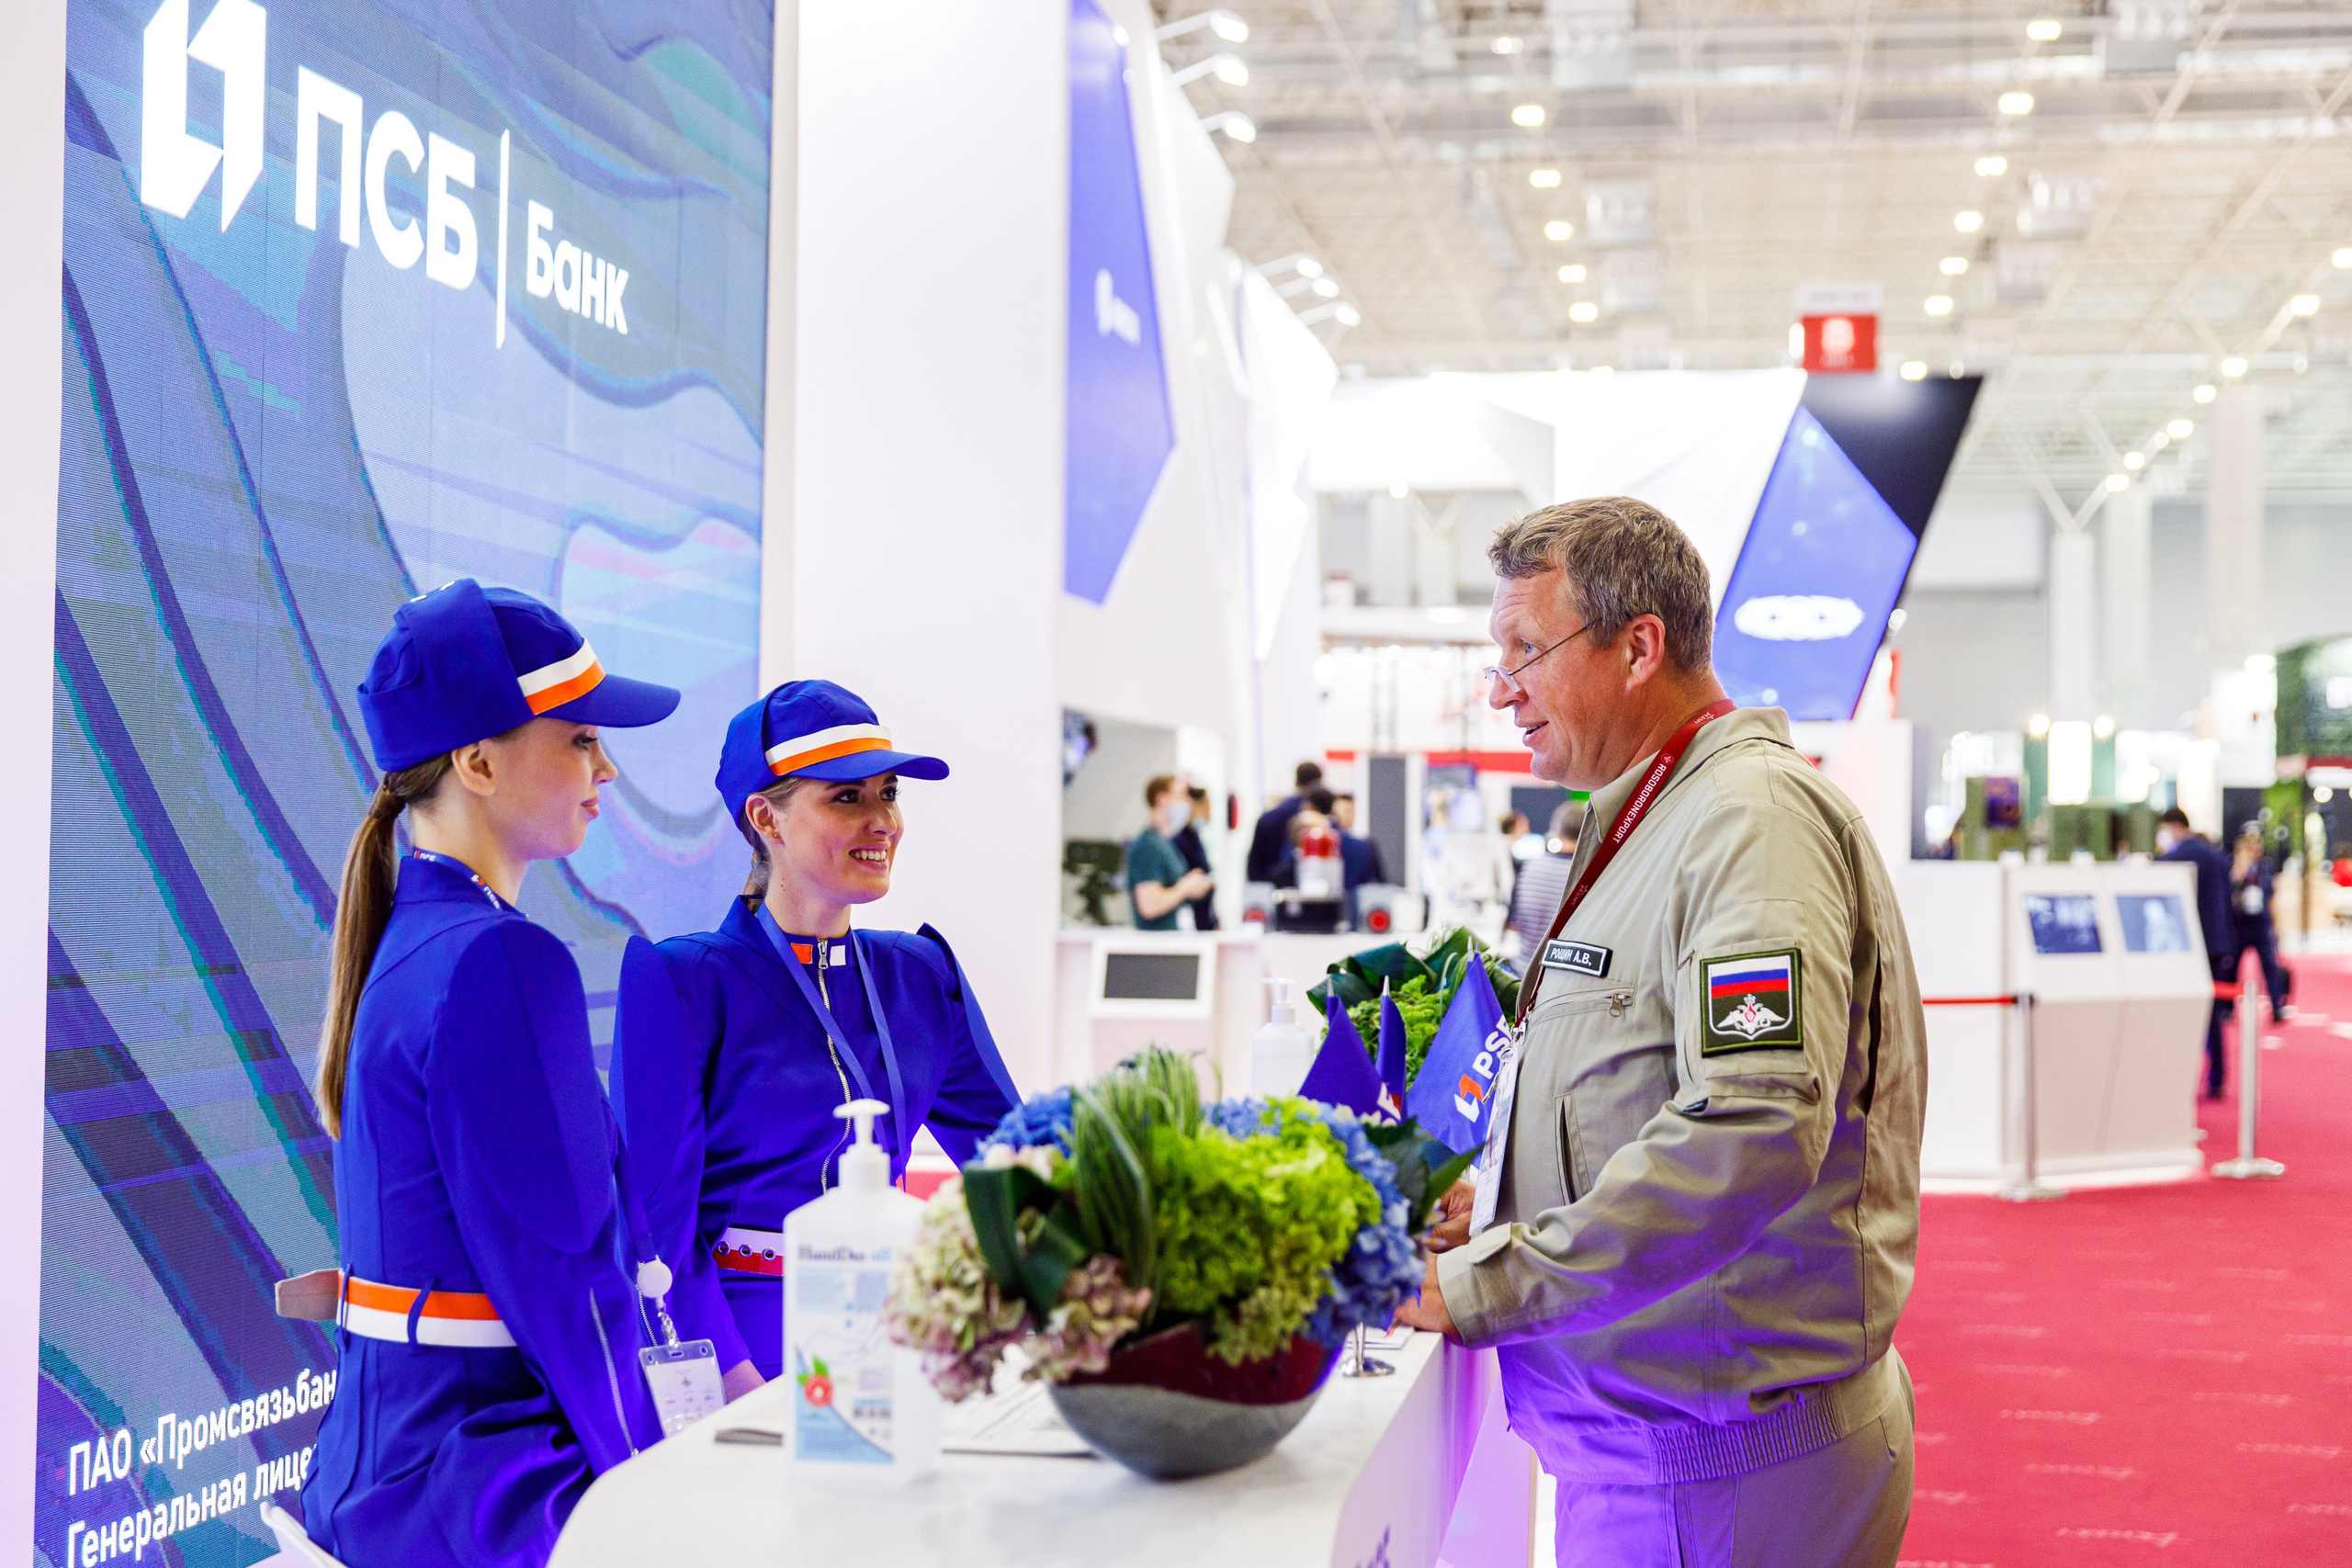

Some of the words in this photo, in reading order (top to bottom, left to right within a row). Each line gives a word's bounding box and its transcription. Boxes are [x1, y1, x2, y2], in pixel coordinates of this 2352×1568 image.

[295, 65, 479, 290] ПСБ
[526, 199, 628, 335] Банк
[1612, 763, 1668, 844] ROSOBORONEXPORT
[69, 1429, 132, 1496] ПАО
[140, 1368, 337, 1470] «Промсвязьбан
[67, 1472, 246, 1568] Генеральная
[253, 1443, 317, 1500] лице
